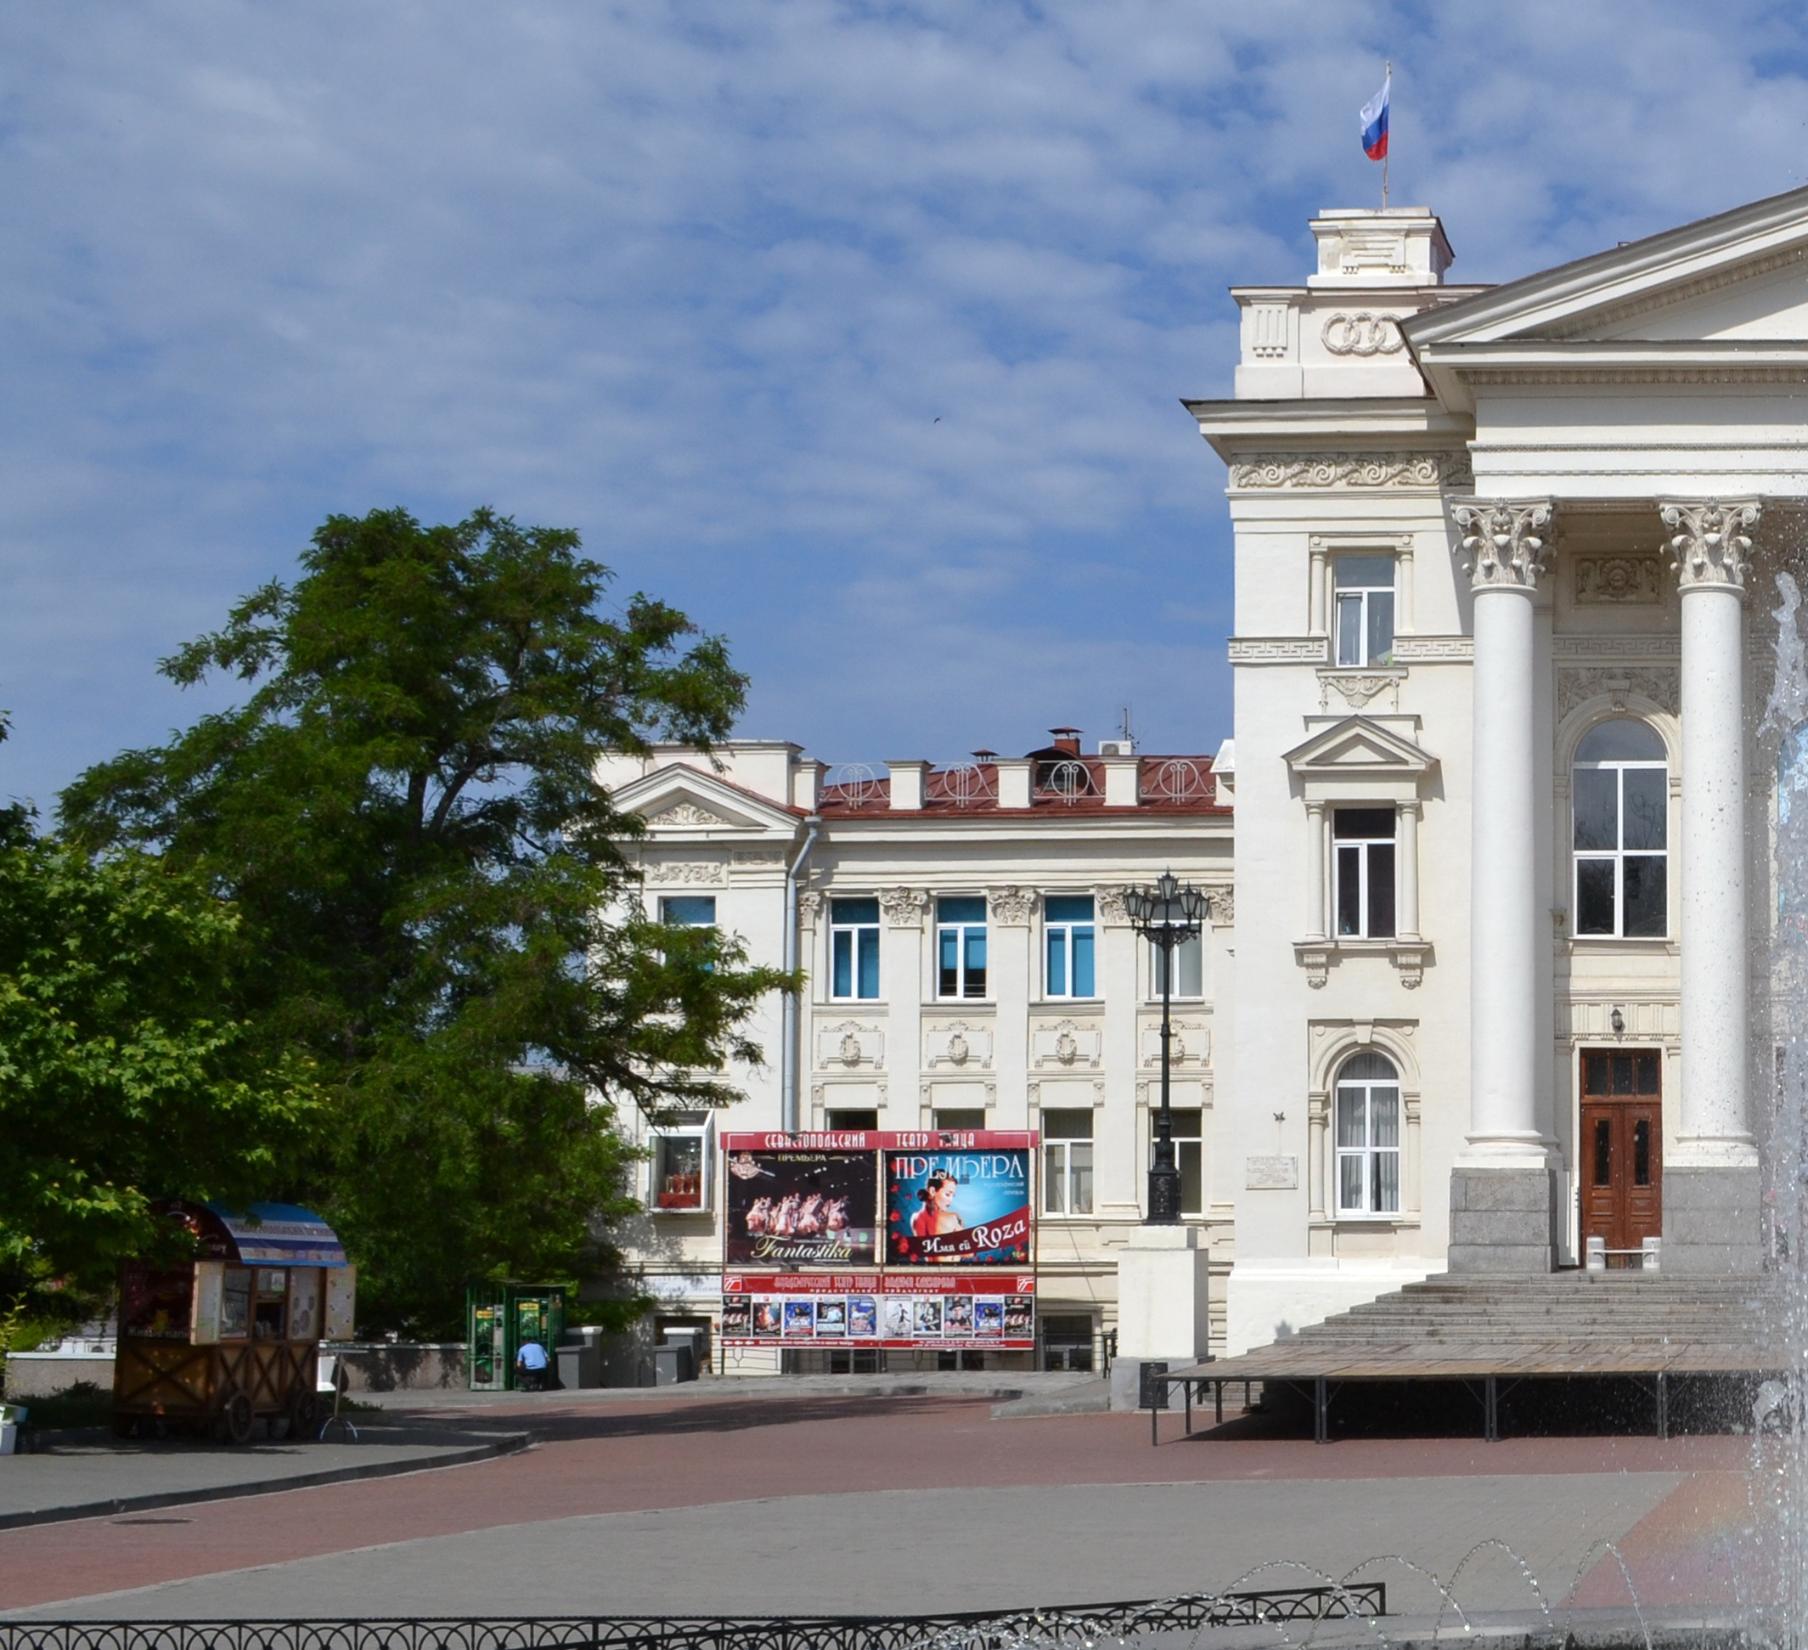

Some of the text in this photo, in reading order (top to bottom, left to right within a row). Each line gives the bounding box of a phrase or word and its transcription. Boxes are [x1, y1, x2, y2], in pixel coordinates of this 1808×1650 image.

[896, 1132, 929, 1148] ТЕАТР
[894, 1154, 1025, 1180] ПРЕМЬЕРА
[750, 1231, 853, 1259] Fantastika
[921, 1236, 956, 1253] Имя
[972, 1219, 1027, 1249] Roza
